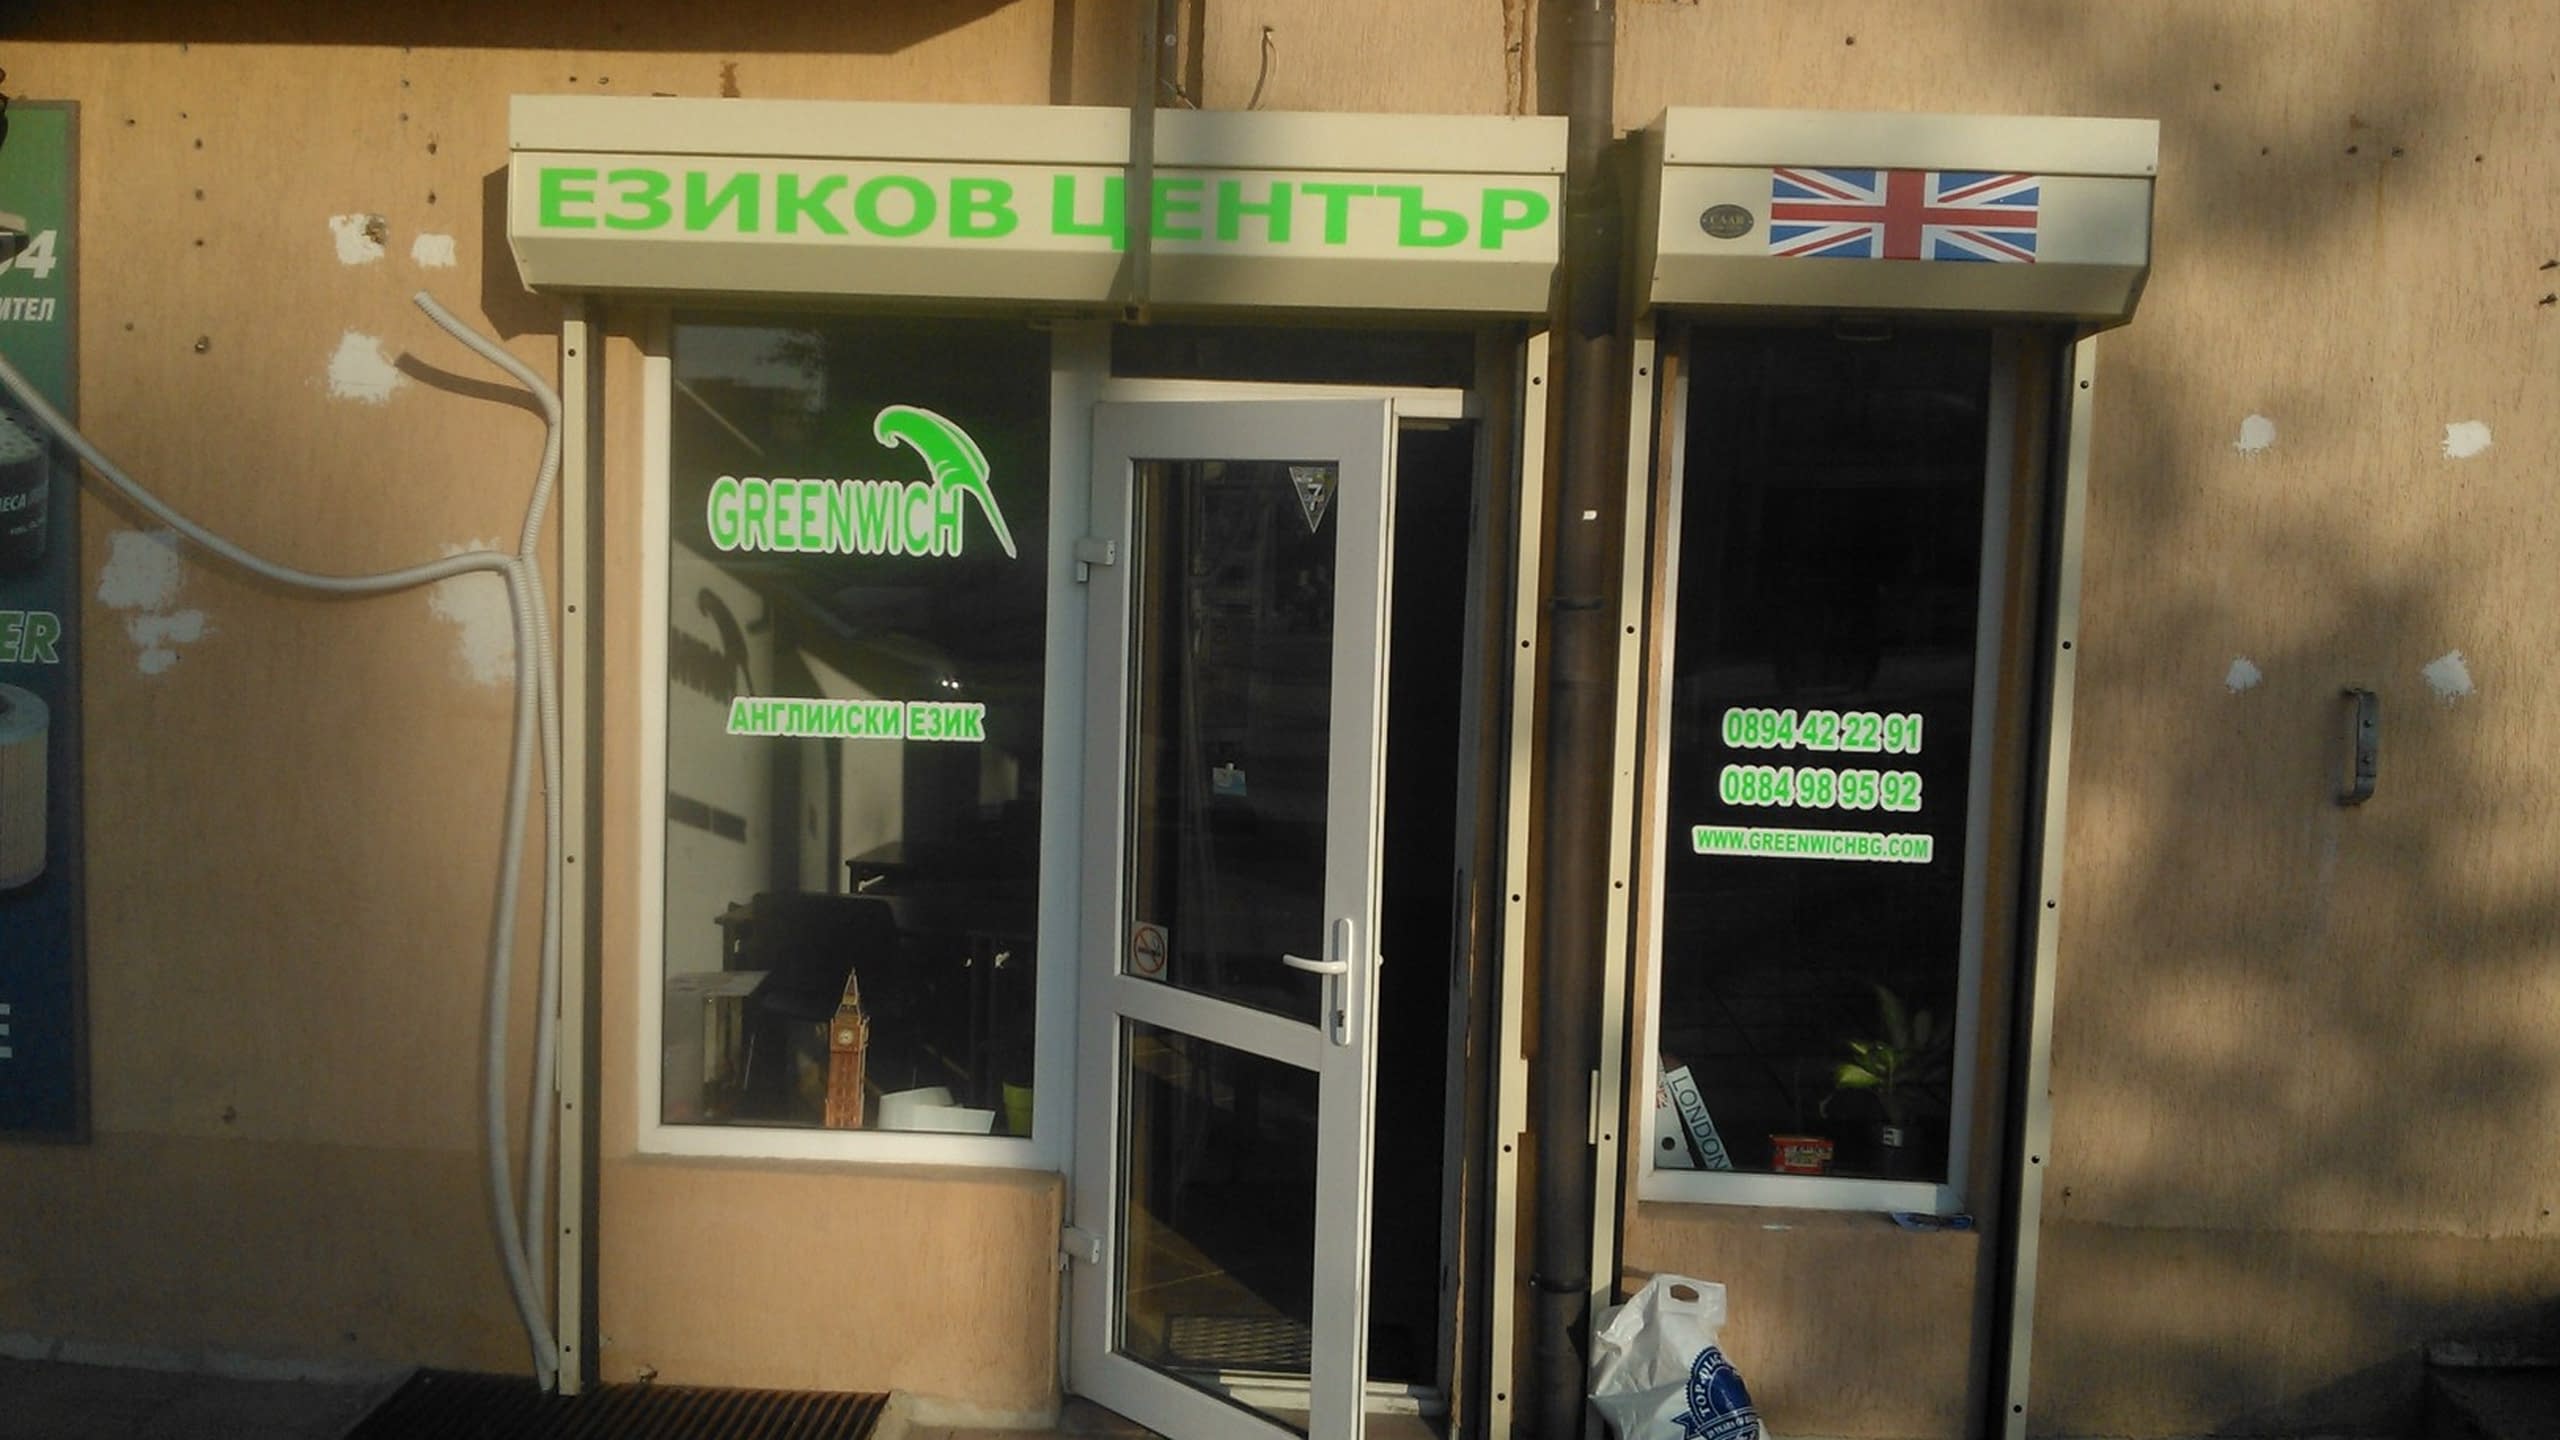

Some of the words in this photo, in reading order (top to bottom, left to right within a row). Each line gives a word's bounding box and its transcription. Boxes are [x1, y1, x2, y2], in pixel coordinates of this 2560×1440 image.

[538, 167, 1019, 239] ЕЗИКОВ
[1051, 174, 1551, 252] ЦЕНТЪР
[0, 230, 57, 279] 4
[709, 478, 961, 556] GREENWICH
[909, 704, 981, 738] ЕЗИК
[1726, 711, 1795, 745] 0894
[1801, 714, 1837, 747] 42
[1843, 715, 1878, 748] 22
[1886, 716, 1919, 749] 91
[1723, 770, 1792, 802] 0884
[1799, 772, 1834, 804] 98
[1841, 774, 1876, 806] 95
[1883, 775, 1918, 807] 92
[1696, 829, 1929, 859] WWW.GREENWICHBG.COM
[1672, 1075, 1729, 1168] LONDON
